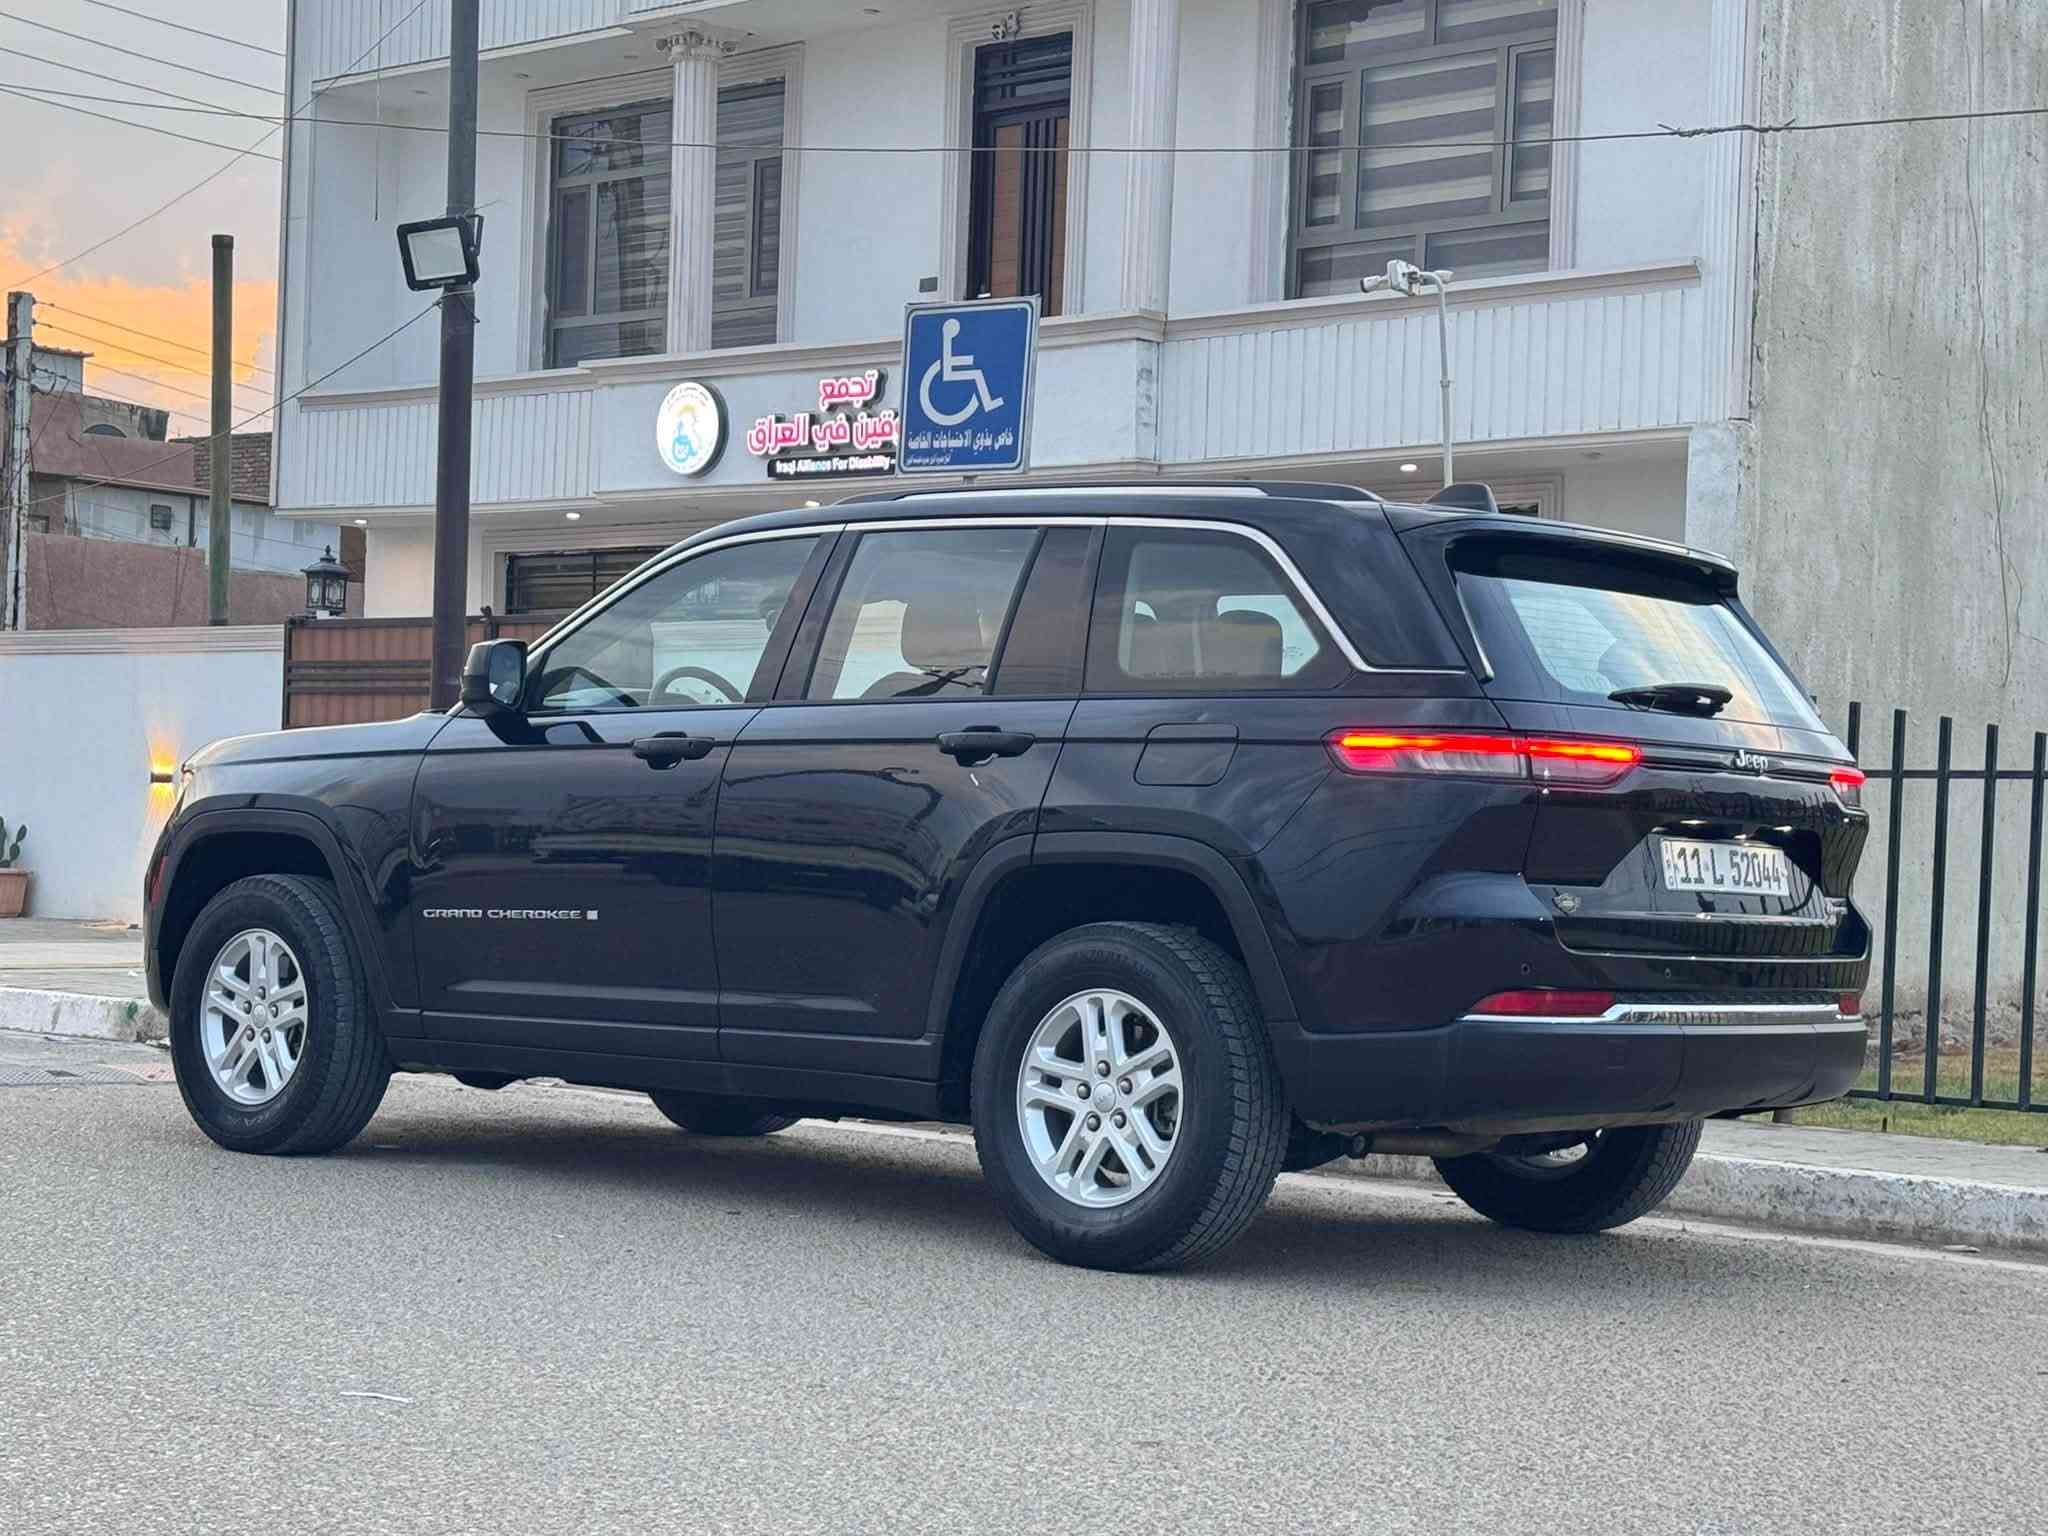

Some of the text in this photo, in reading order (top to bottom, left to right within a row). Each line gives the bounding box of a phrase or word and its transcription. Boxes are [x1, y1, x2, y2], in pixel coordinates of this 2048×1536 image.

[819, 369, 878, 411] تجمع
[747, 413, 810, 454] العراق
[812, 413, 850, 453] في
[908, 431, 931, 449] الخاصة
[994, 427, 1014, 451] خاص
[776, 459, 796, 475] Iraqi
[832, 457, 848, 471] For
[848, 455, 890, 470] Disability
[1736, 749, 1769, 772] Jeep
[1677, 847, 1704, 884] 11
[1729, 849, 1782, 890] 52044
[423, 909, 582, 920] GRAND CHEROKEE
